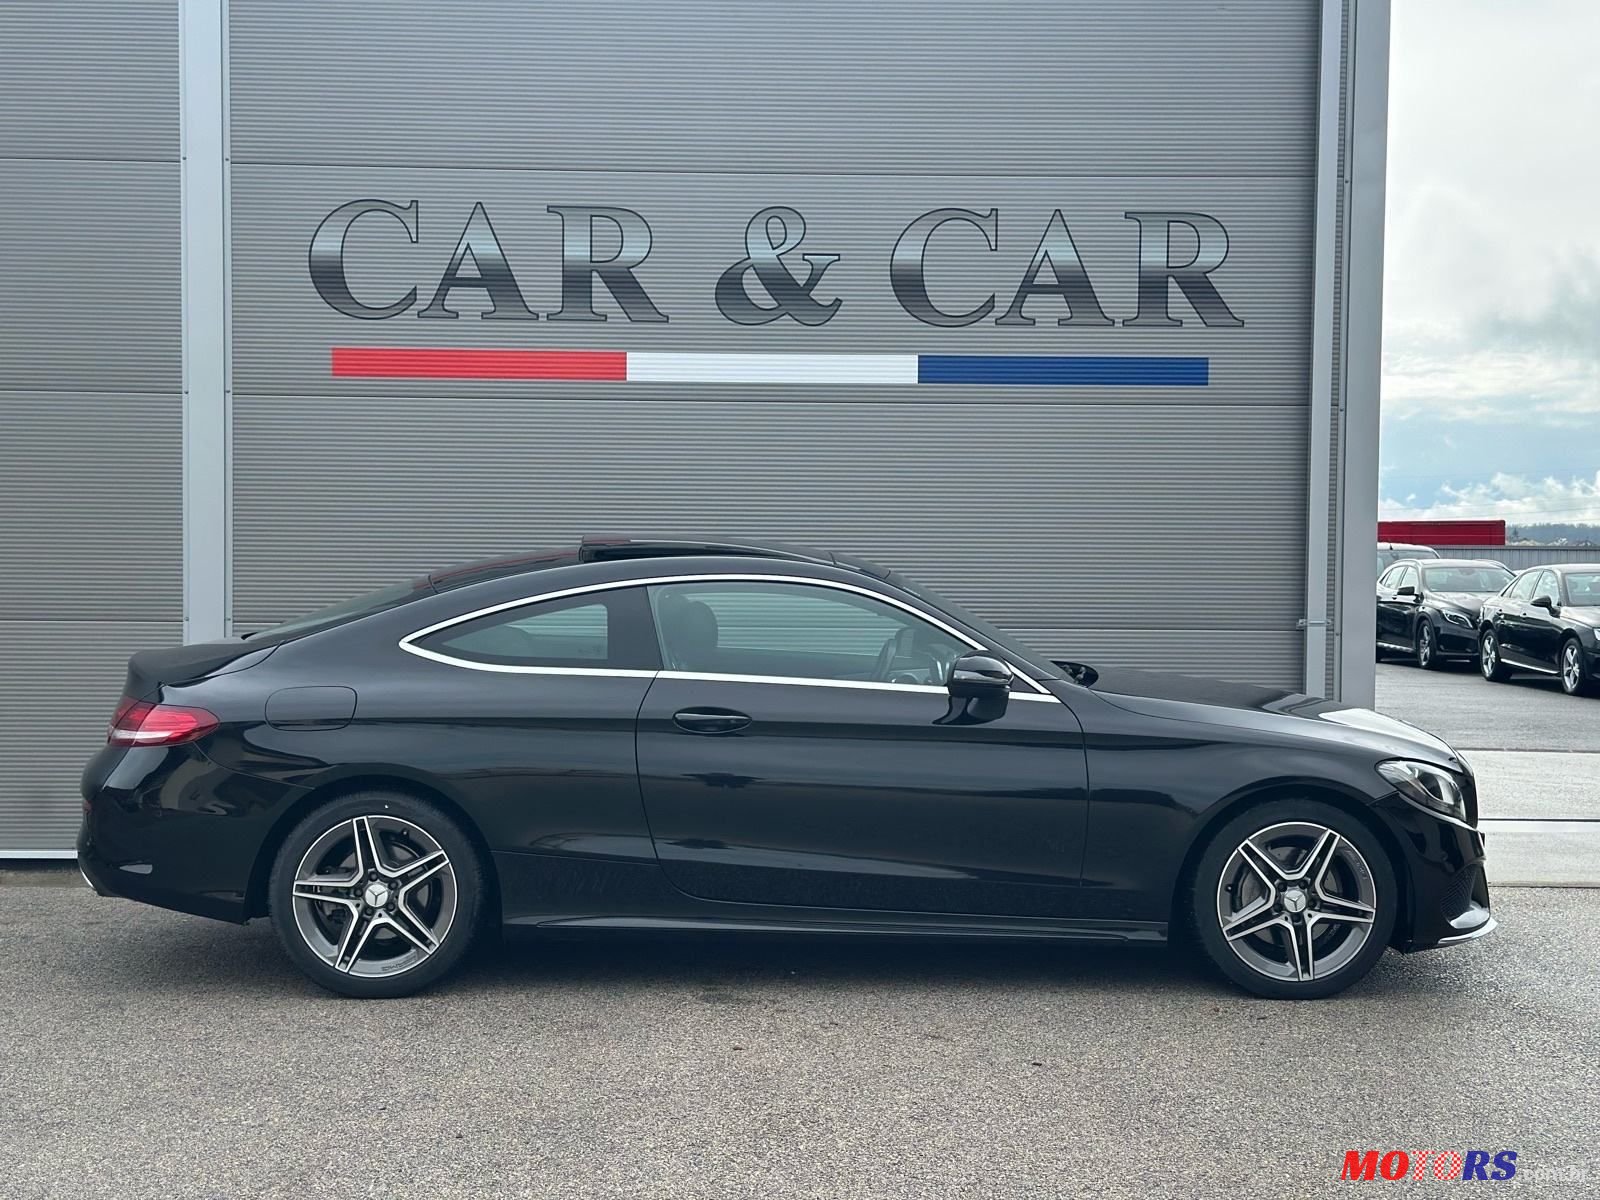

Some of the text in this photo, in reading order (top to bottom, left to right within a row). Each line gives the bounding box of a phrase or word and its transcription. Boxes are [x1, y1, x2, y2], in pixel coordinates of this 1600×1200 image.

[308, 199, 1245, 328] CAR & CAR
